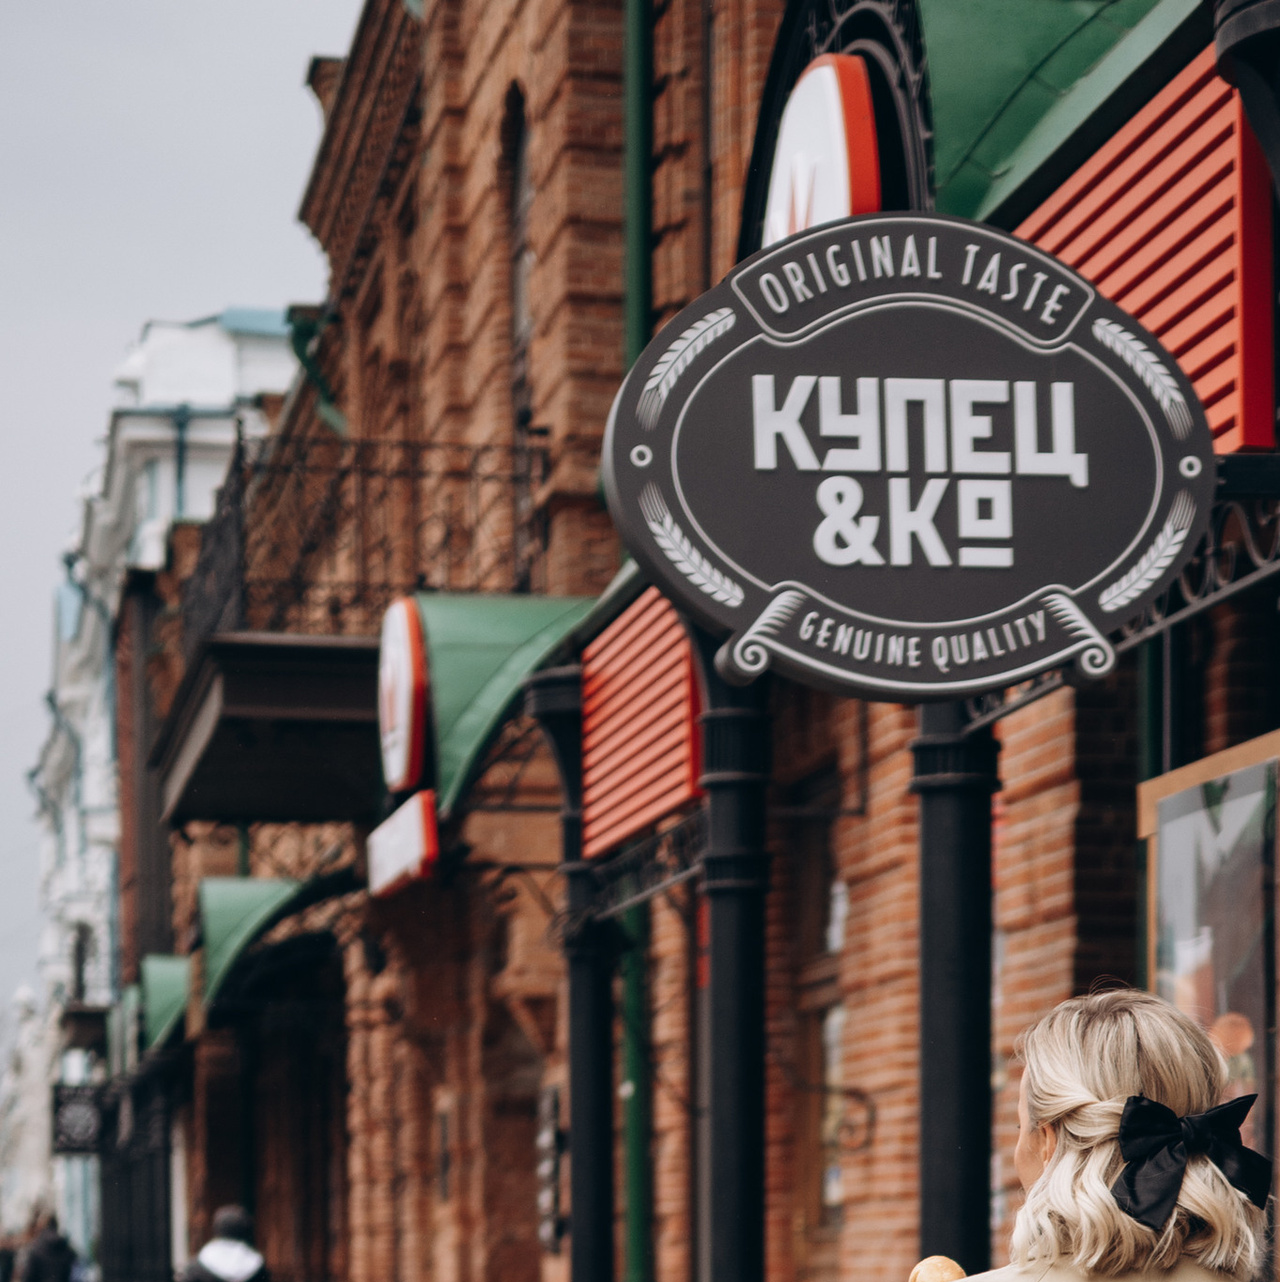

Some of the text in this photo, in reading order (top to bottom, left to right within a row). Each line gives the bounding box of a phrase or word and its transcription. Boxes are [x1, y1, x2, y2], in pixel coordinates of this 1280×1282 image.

[758, 234, 1070, 325] ORIGINAL TASTE
[752, 374, 1089, 488] КУПЕЦ
[800, 611, 1047, 673] GENUINE QUALITY
